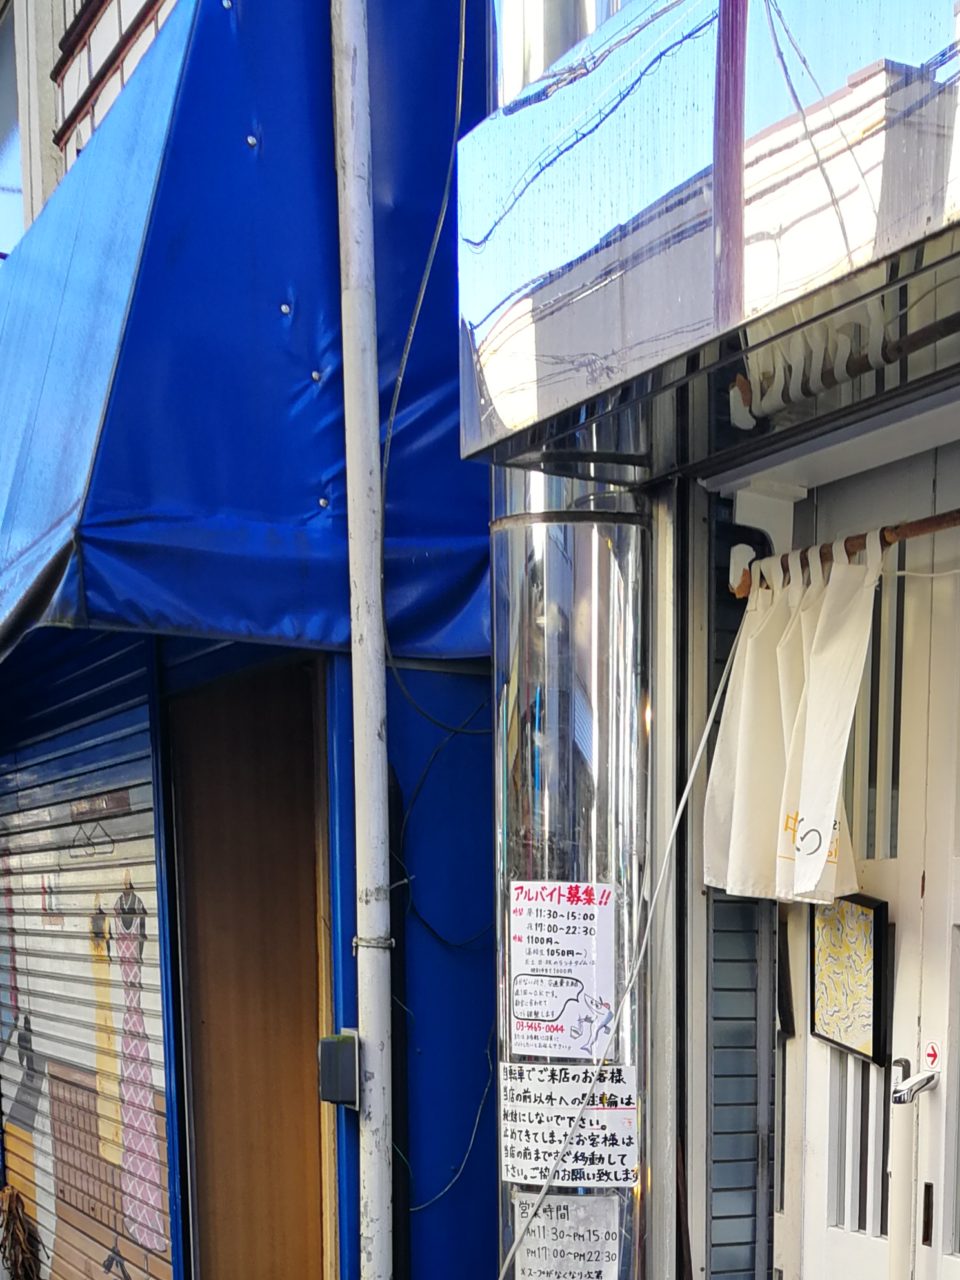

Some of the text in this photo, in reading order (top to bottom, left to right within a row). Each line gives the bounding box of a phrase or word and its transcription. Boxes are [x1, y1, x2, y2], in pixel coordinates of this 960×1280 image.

[514, 884, 611, 906] アルバイト募集!!
